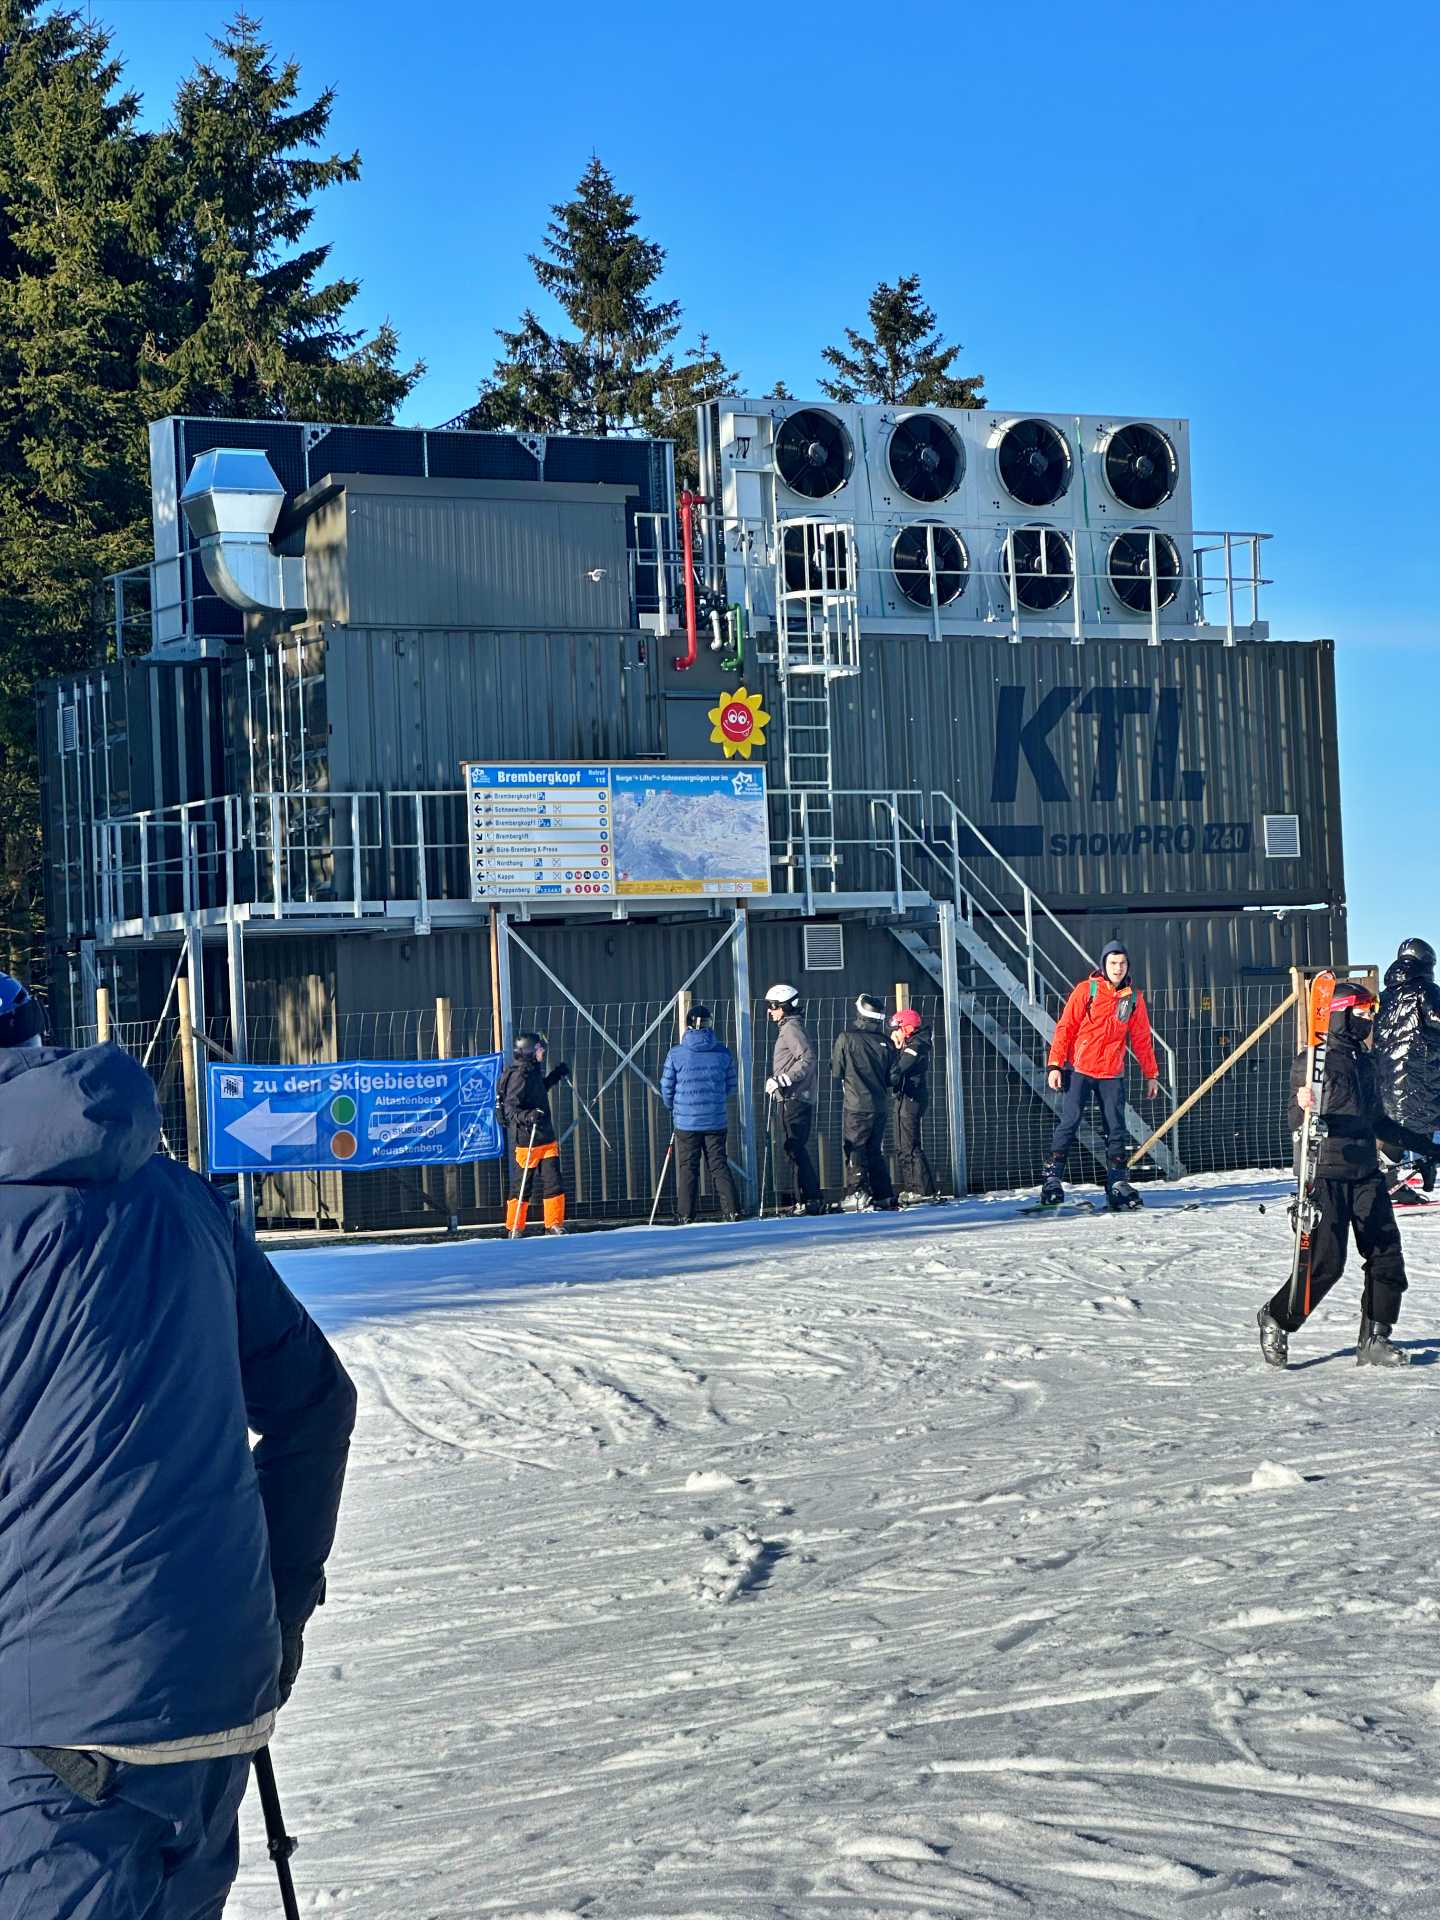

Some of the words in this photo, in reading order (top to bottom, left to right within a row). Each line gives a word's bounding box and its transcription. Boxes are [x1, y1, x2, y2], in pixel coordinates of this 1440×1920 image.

[497, 770, 581, 785] Brembergkopf
[496, 832, 529, 840] Bremberglift
[1050, 824, 1196, 856] snowPRO
[496, 859, 523, 867] Nordhang
[497, 873, 514, 881] Kappe
[498, 886, 531, 894] Poppenberg
[252, 1079, 278, 1093] zu
[284, 1076, 322, 1093] den
[328, 1071, 448, 1094] Skigebieten
[375, 1095, 442, 1106] Altastenberg
[391, 1125, 424, 1137] SKIBUS
[372, 1143, 443, 1156] Neuastenberg
